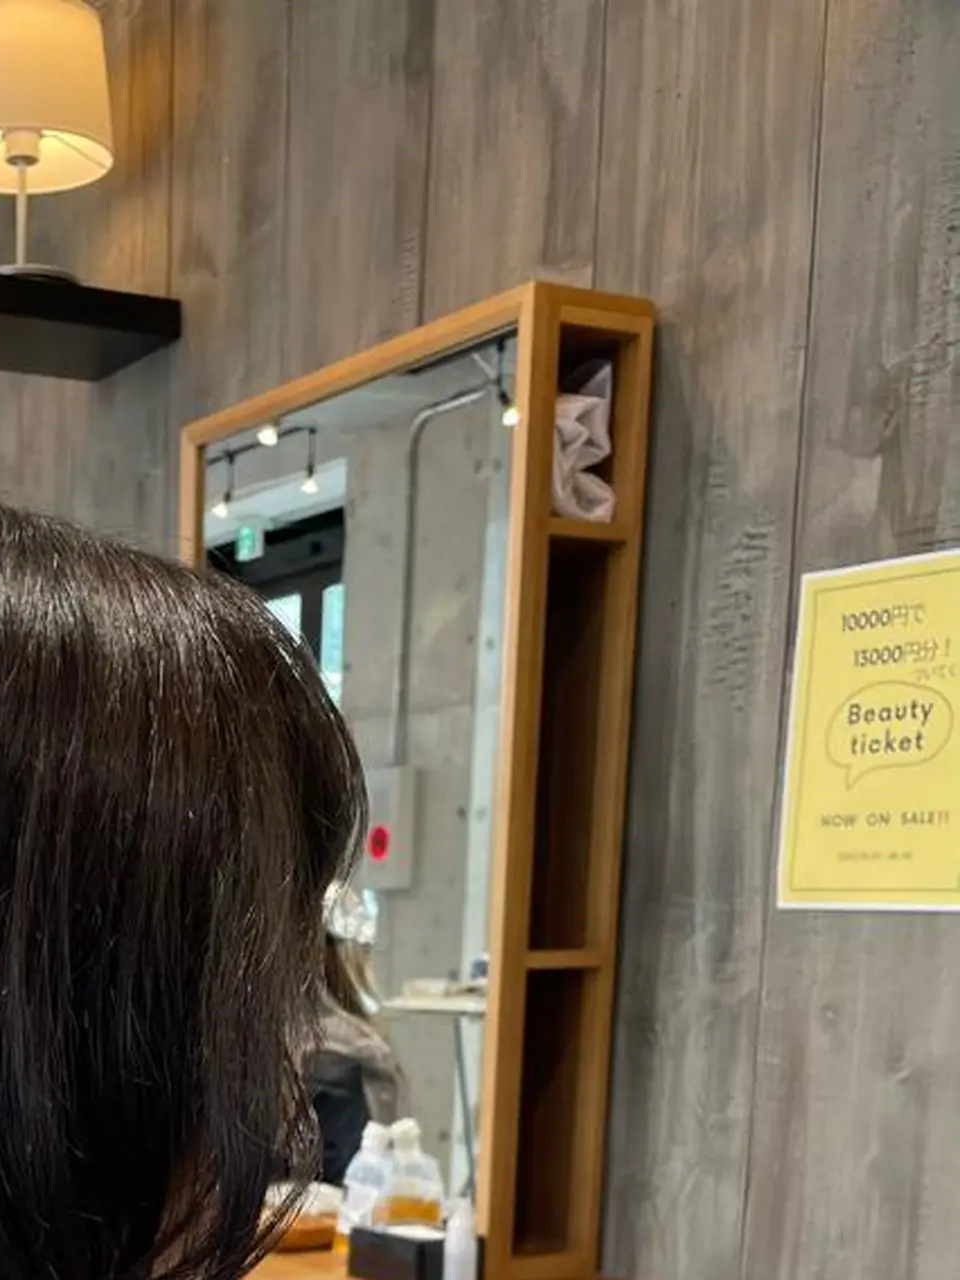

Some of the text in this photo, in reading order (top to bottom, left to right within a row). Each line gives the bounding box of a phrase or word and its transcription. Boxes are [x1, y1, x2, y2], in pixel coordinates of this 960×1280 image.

[847, 700, 933, 725] Beauty
[851, 729, 923, 755] ticket
[821, 813, 857, 827] NOW
[865, 812, 890, 826] ON
